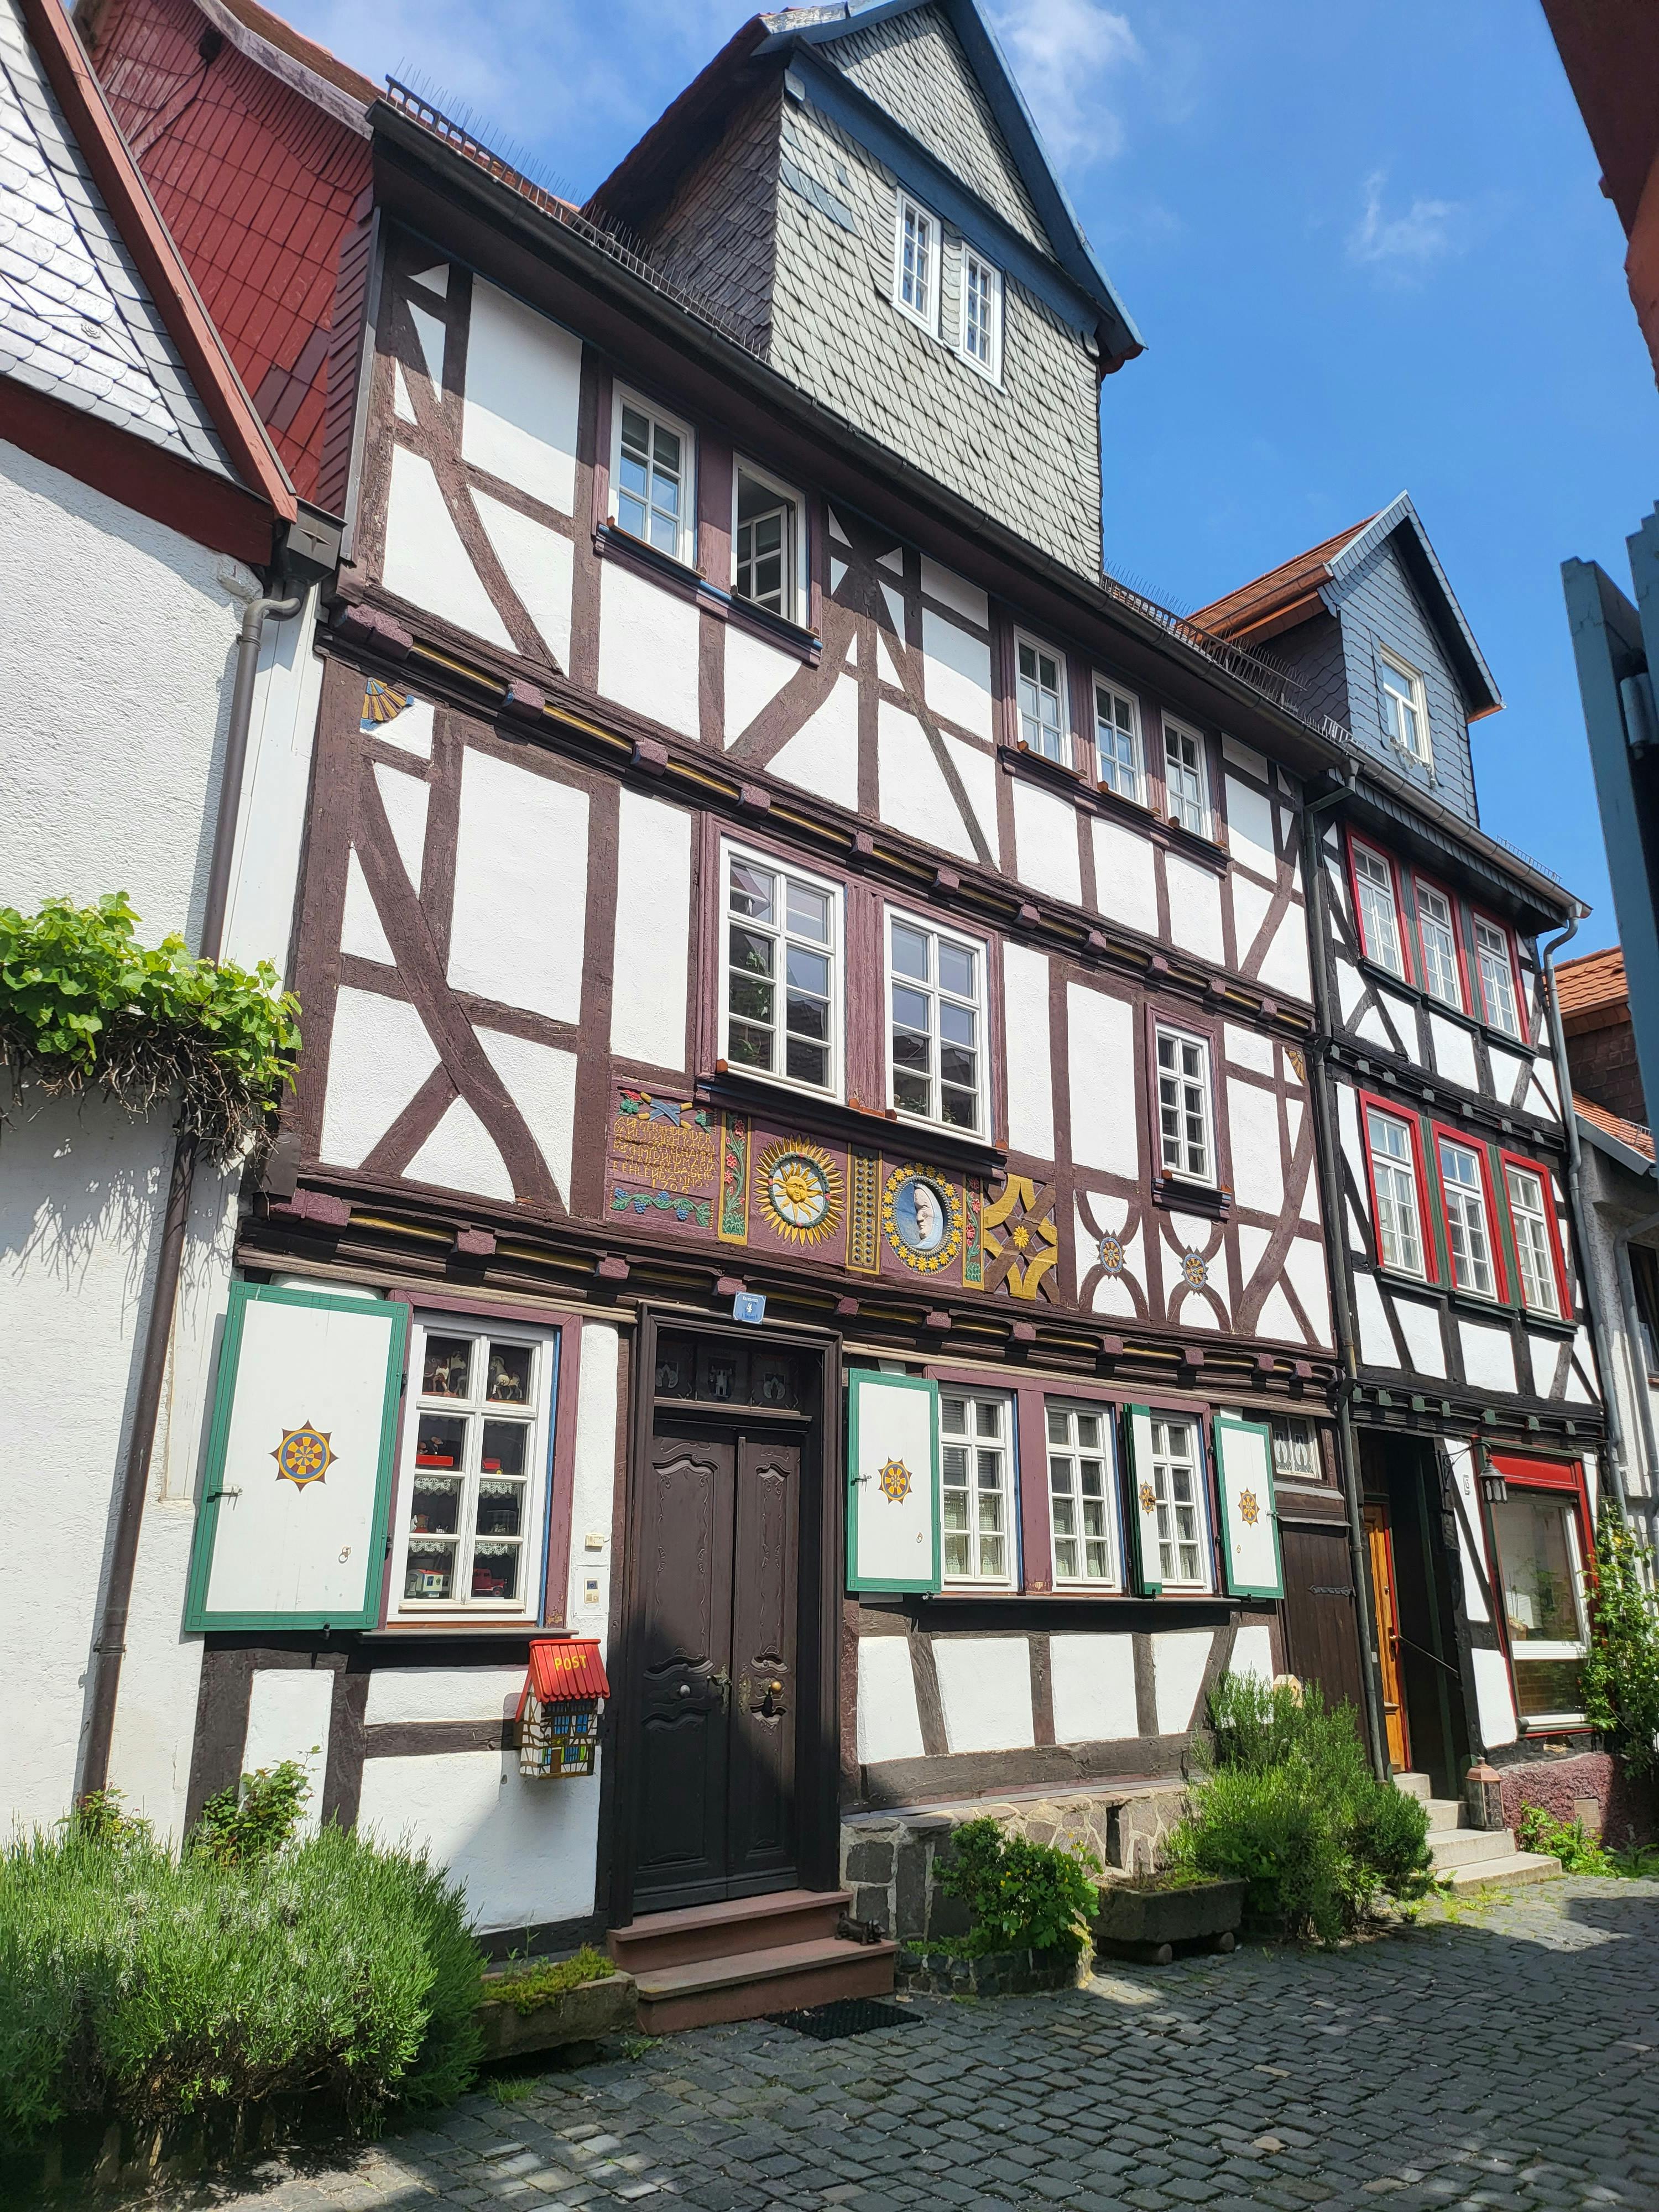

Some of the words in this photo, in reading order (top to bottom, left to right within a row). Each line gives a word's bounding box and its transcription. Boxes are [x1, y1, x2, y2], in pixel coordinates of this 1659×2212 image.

[653, 1178, 690, 1194] 1706
[747, 1302, 753, 1313] 4
[554, 1655, 587, 1671] POST
